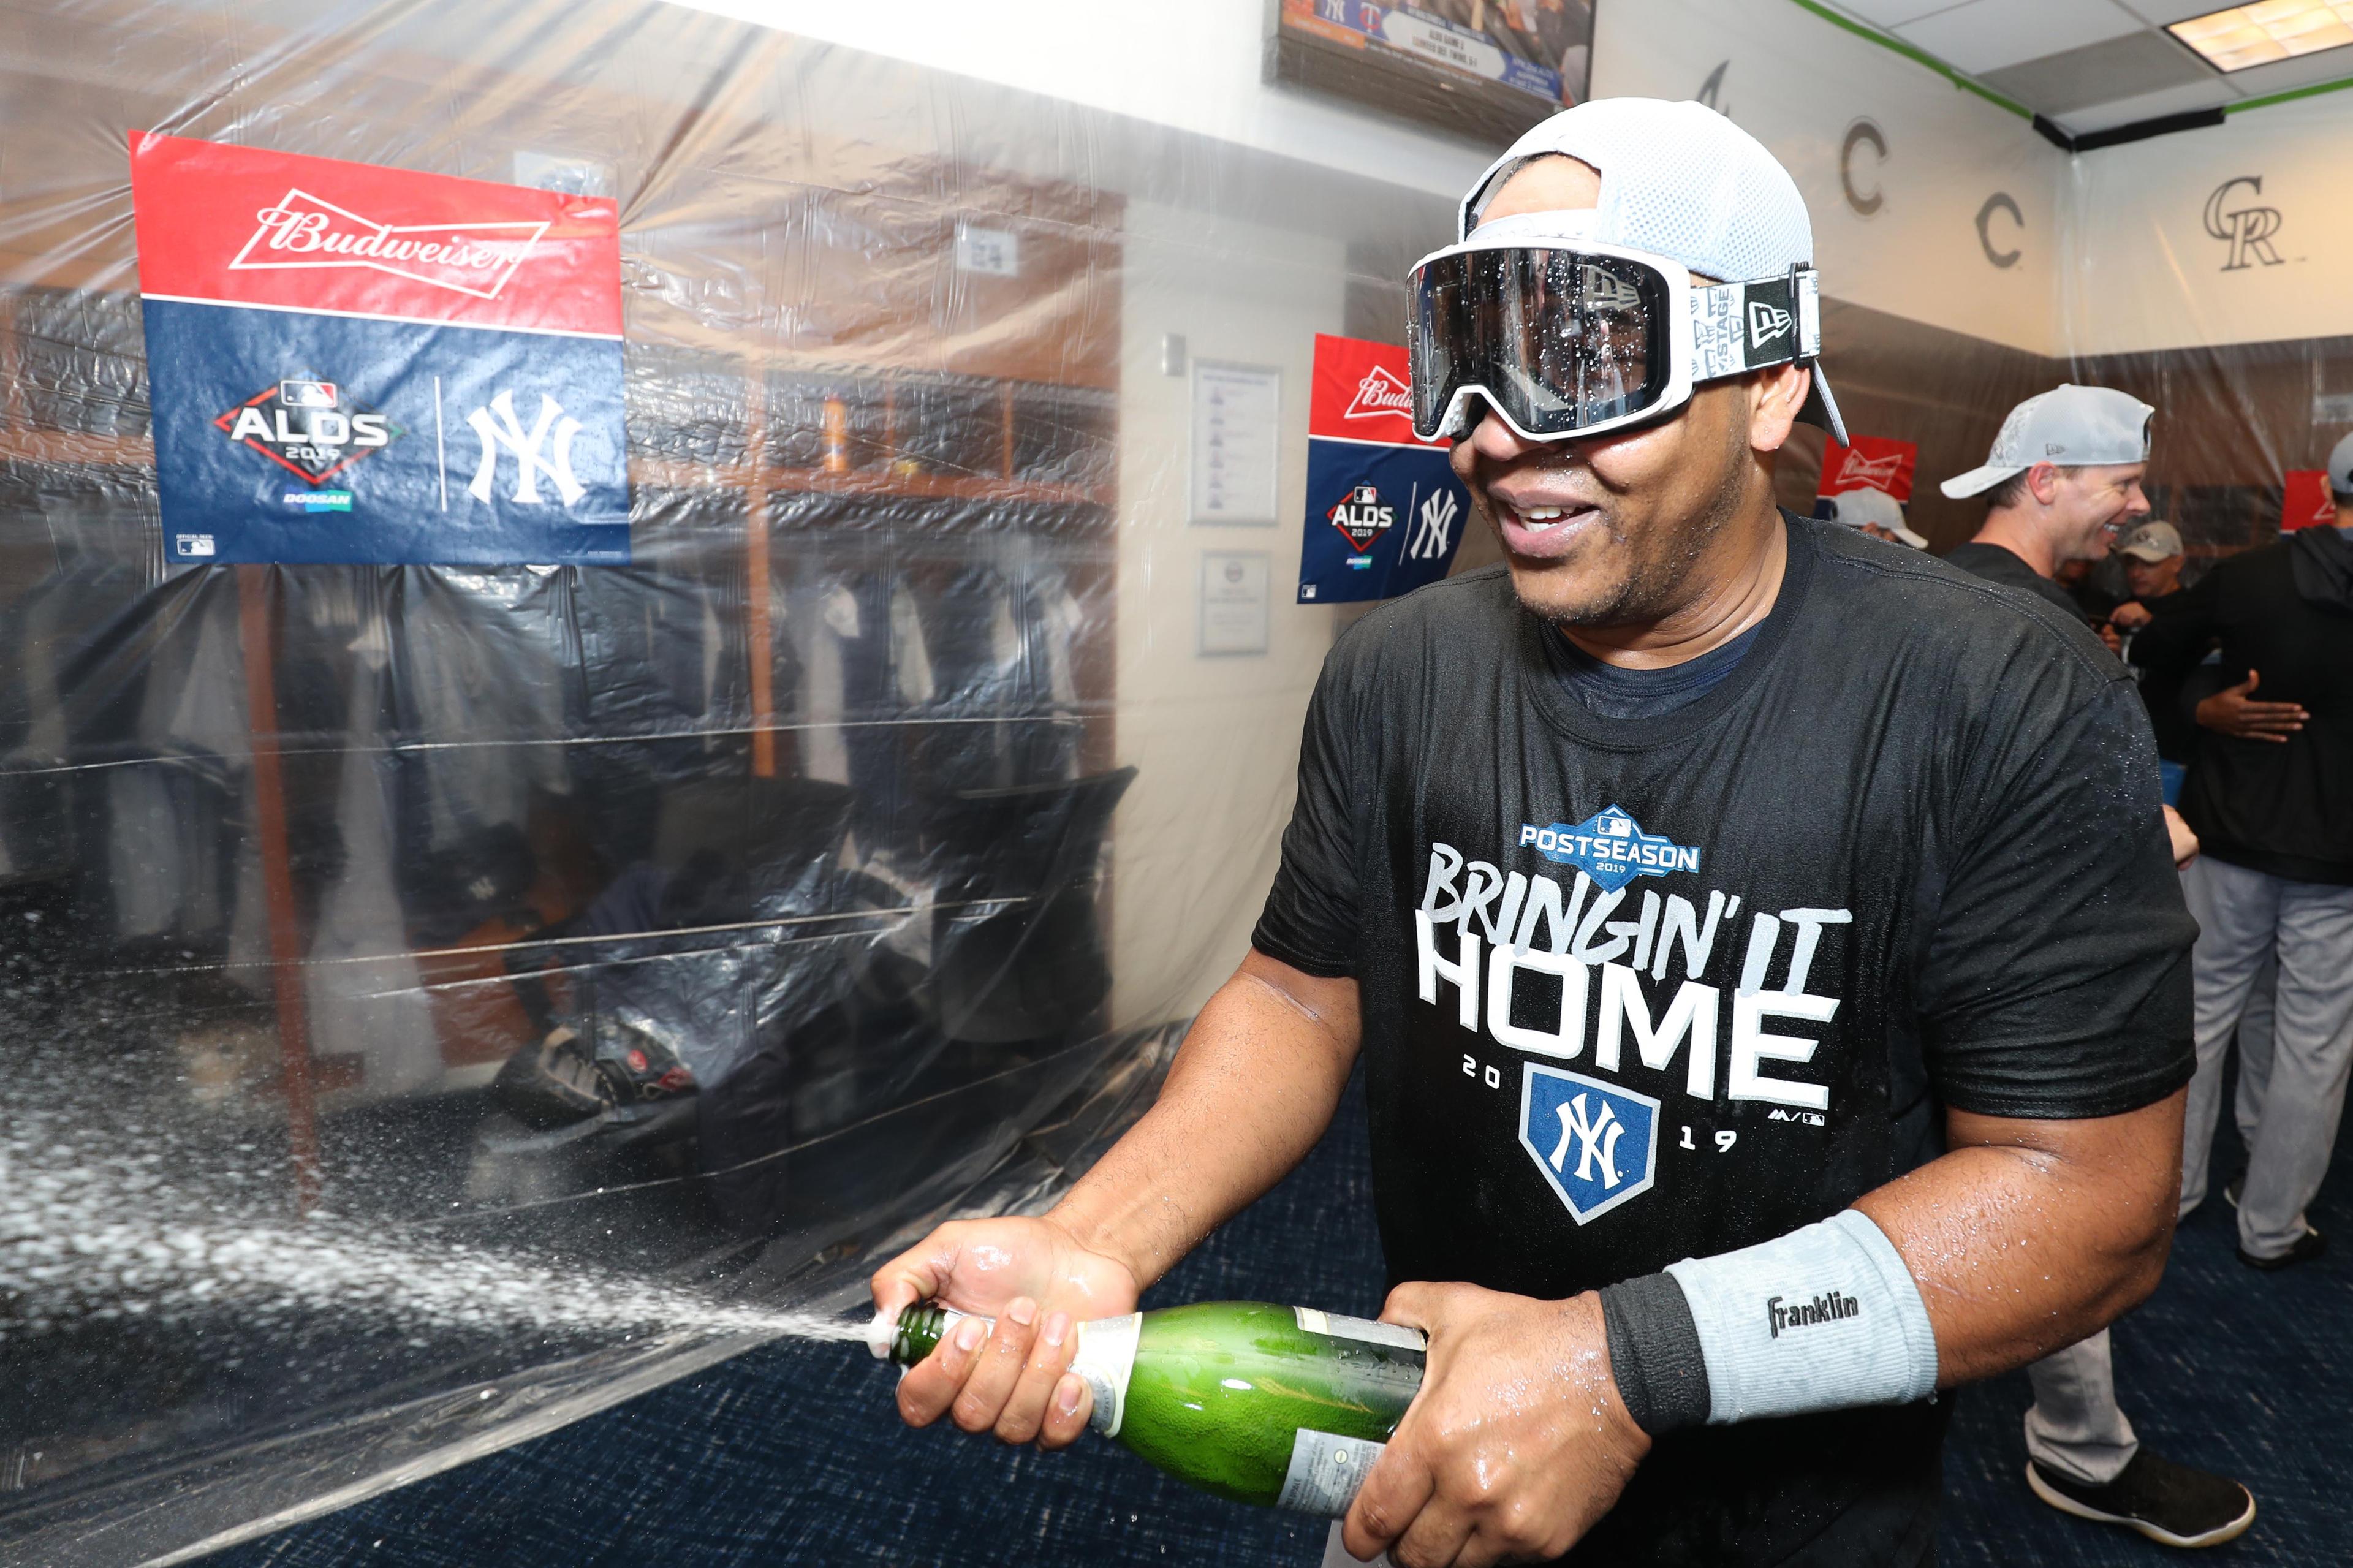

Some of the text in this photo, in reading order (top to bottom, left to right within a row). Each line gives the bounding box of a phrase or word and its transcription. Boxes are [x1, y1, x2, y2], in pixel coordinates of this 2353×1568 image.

[256, 206, 520, 272] Budweiser
[1359, 377, 1412, 408] Bud
[230, 406, 390, 447] ALDS
[286, 445, 341, 461] 2019
[283, 493, 352, 504] DOOSAN
[1332, 504, 1393, 528] ALDS
[1351, 528, 1373, 537] 2019
[1521, 823, 1699, 871] POSTSEASON
[1595, 861, 1627, 874] 2019
[1422, 842, 1854, 997] BRINGIN' IT
[1415, 909, 1841, 1110] HOME
[1768, 1290, 1859, 1339] Franklin
